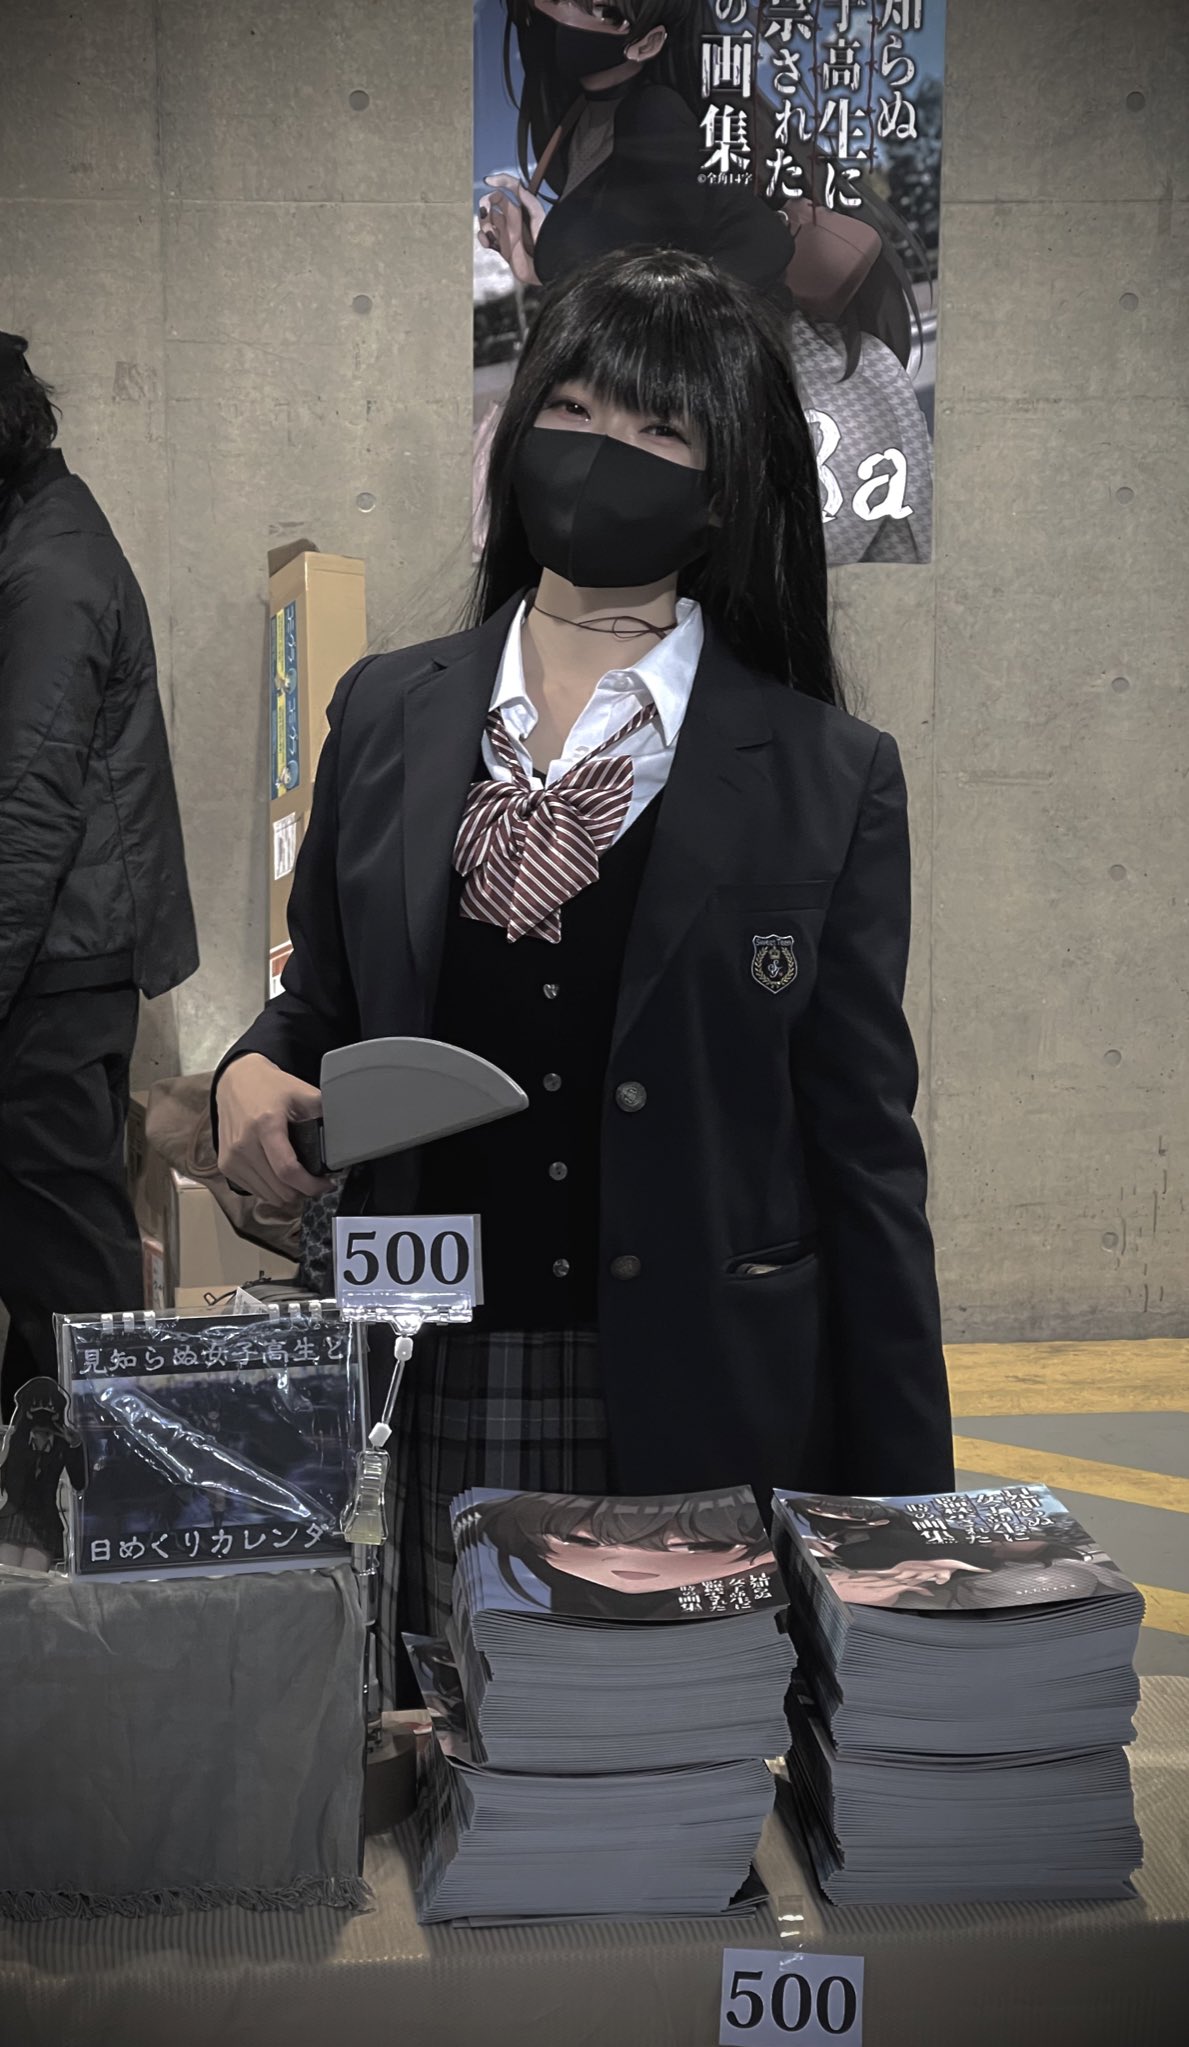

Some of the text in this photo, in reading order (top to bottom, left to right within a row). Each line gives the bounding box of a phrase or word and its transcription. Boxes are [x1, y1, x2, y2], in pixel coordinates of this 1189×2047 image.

[343, 1231, 469, 1285] 500
[79, 1336, 344, 1375] 見知らぬ女子高生と
[726, 1970, 857, 2035] 500
